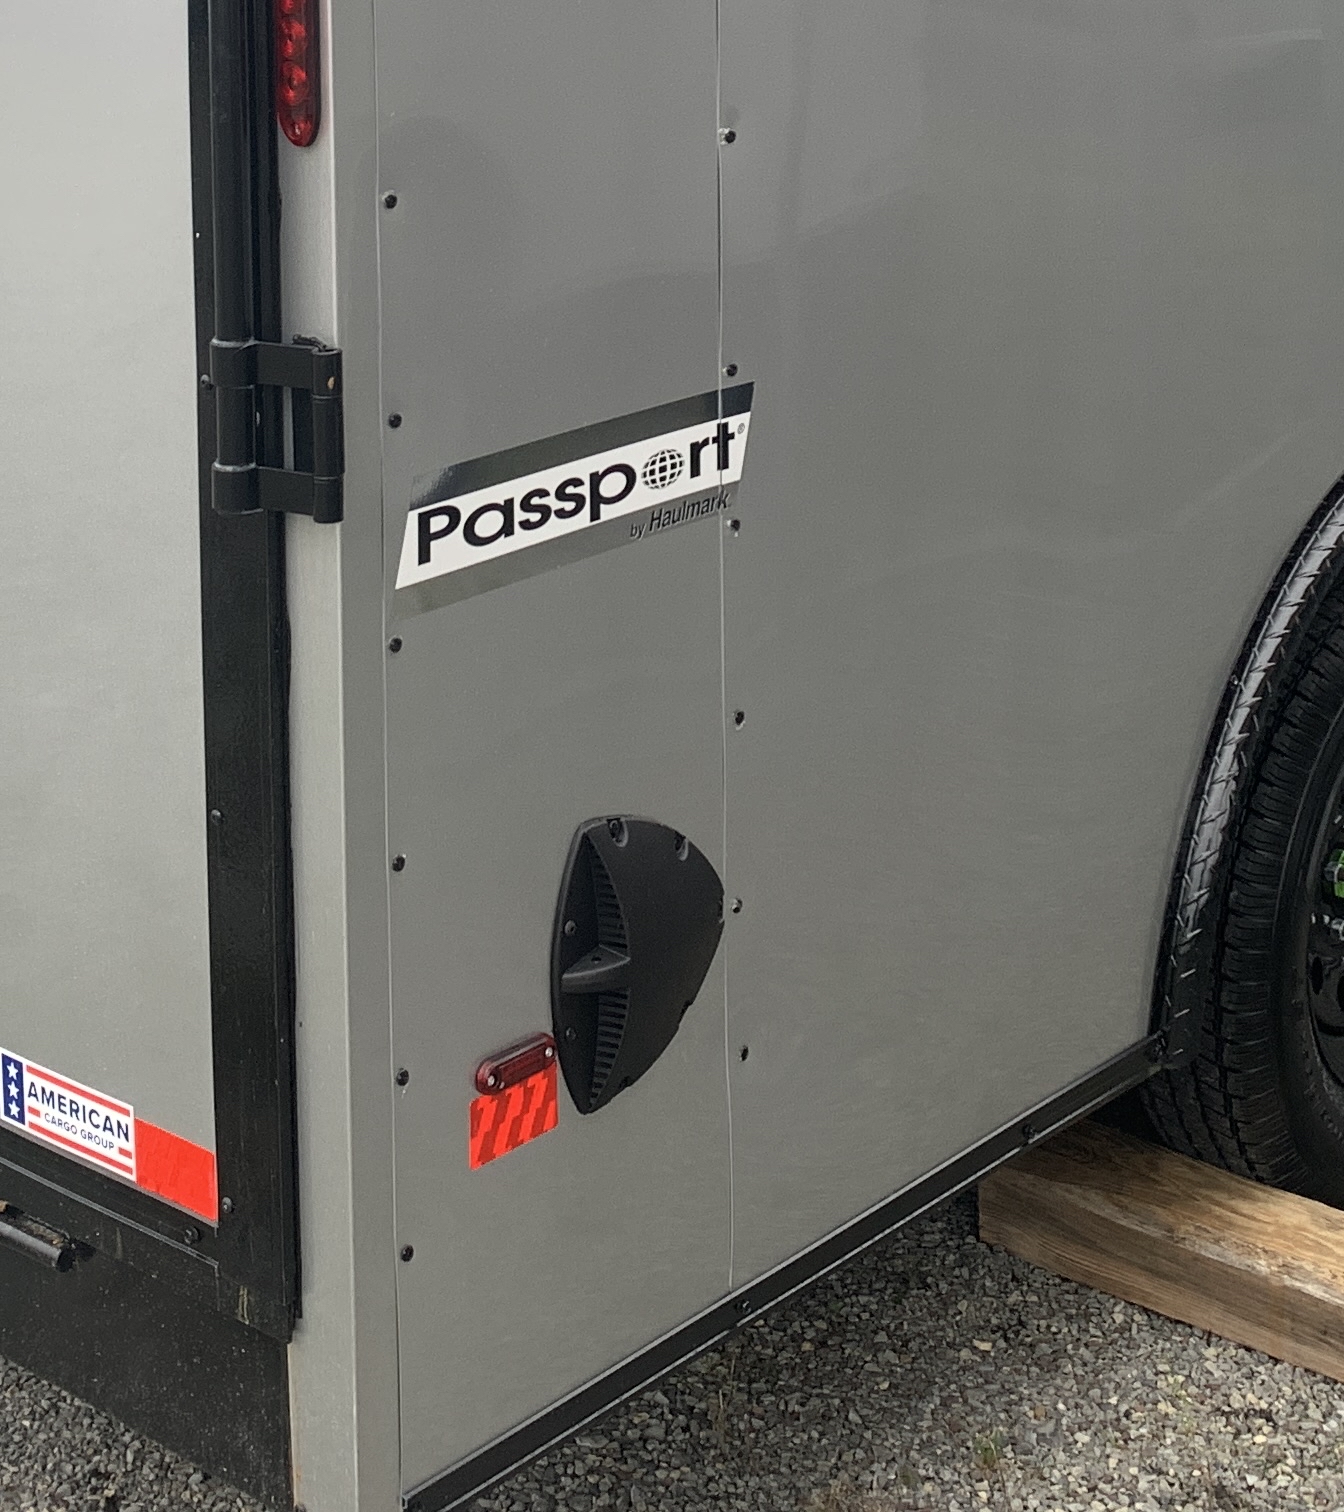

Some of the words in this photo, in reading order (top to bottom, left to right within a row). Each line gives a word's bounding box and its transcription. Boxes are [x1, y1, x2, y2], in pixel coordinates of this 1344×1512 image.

[628, 521, 646, 540] by
[648, 488, 730, 534] Haulmark
[27, 1080, 130, 1144] AMERICAN
[44, 1111, 78, 1136] CARGO
[80, 1128, 115, 1152] GROUP
